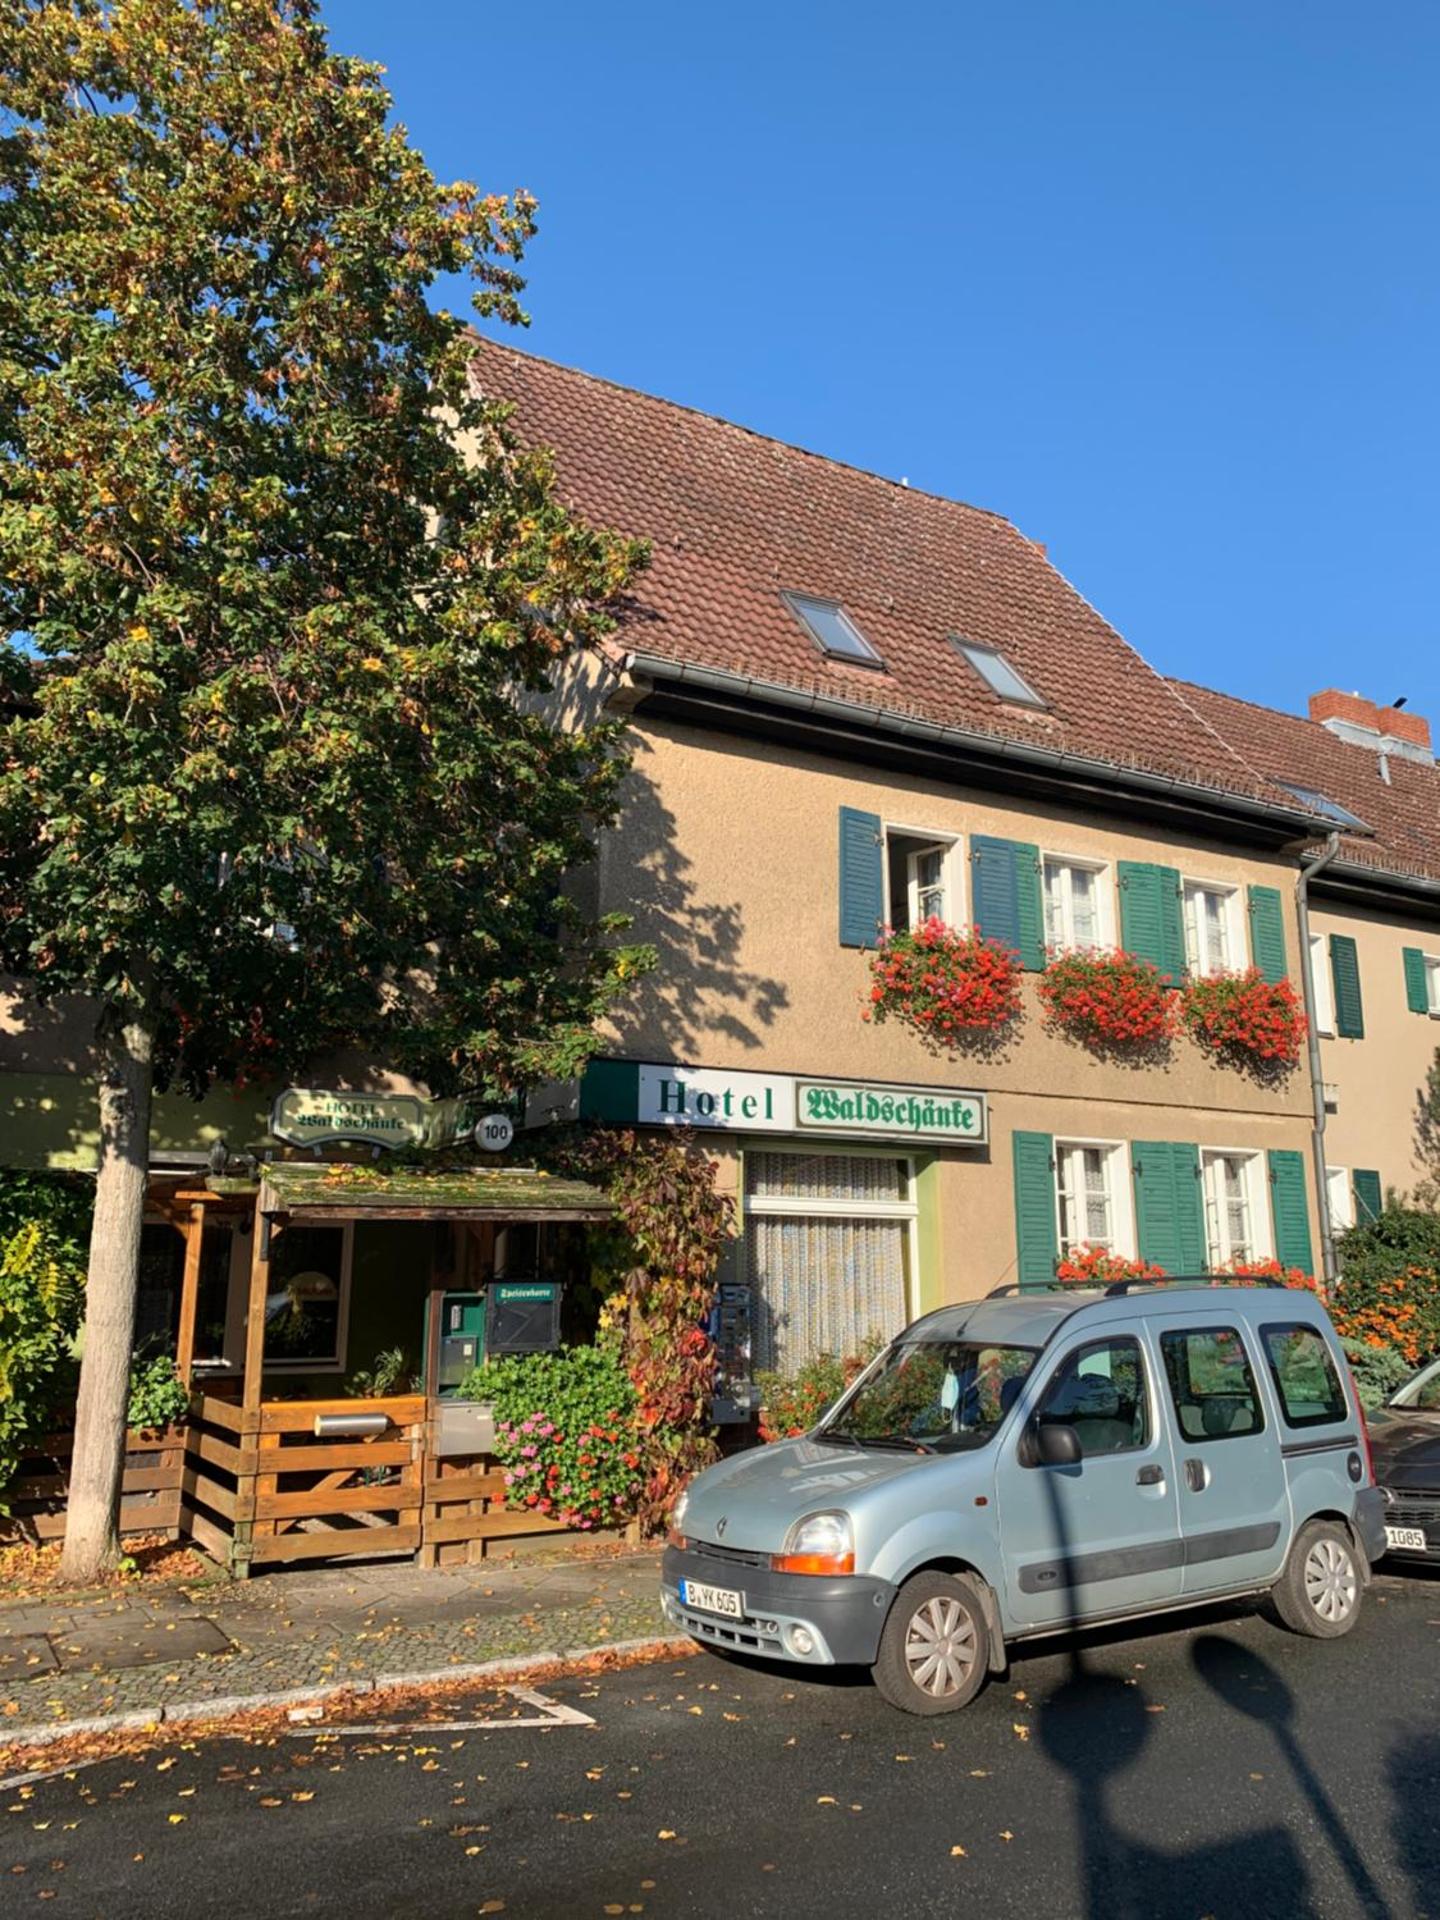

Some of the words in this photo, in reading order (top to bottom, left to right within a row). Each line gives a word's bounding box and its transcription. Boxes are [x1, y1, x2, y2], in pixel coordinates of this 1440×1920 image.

[325, 1102, 376, 1115] HOTEL
[657, 1079, 774, 1120] Hotel
[806, 1087, 974, 1132] Waldschänke
[485, 1124, 508, 1140] 100
[1390, 1530, 1423, 1547] 1085
[688, 1584, 696, 1603] B
[716, 1591, 736, 1614] 605
